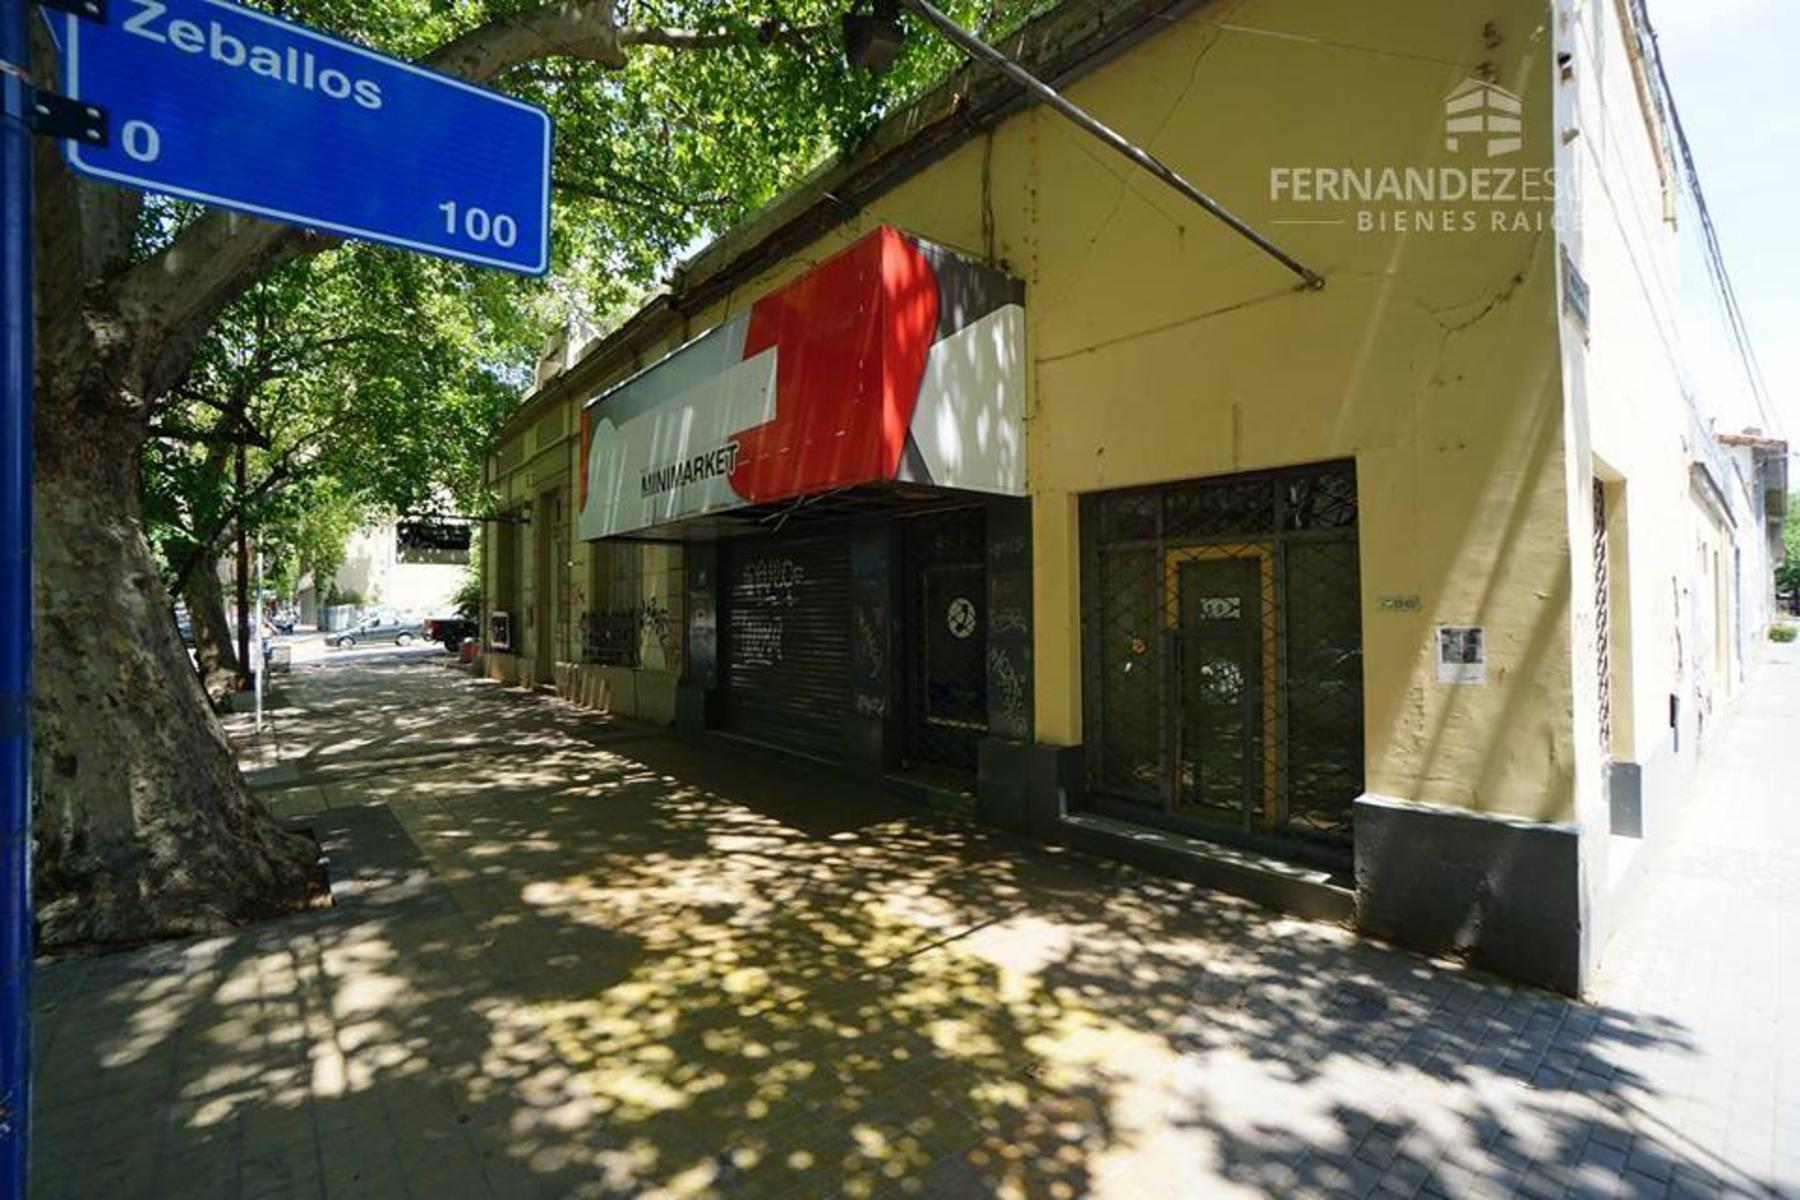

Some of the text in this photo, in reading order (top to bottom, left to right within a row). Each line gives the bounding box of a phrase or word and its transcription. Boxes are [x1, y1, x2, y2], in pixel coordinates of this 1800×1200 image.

[122, 0, 383, 110] Zeballos
[121, 120, 518, 248] 0 100
[641, 441, 739, 497] MINIMARKET
